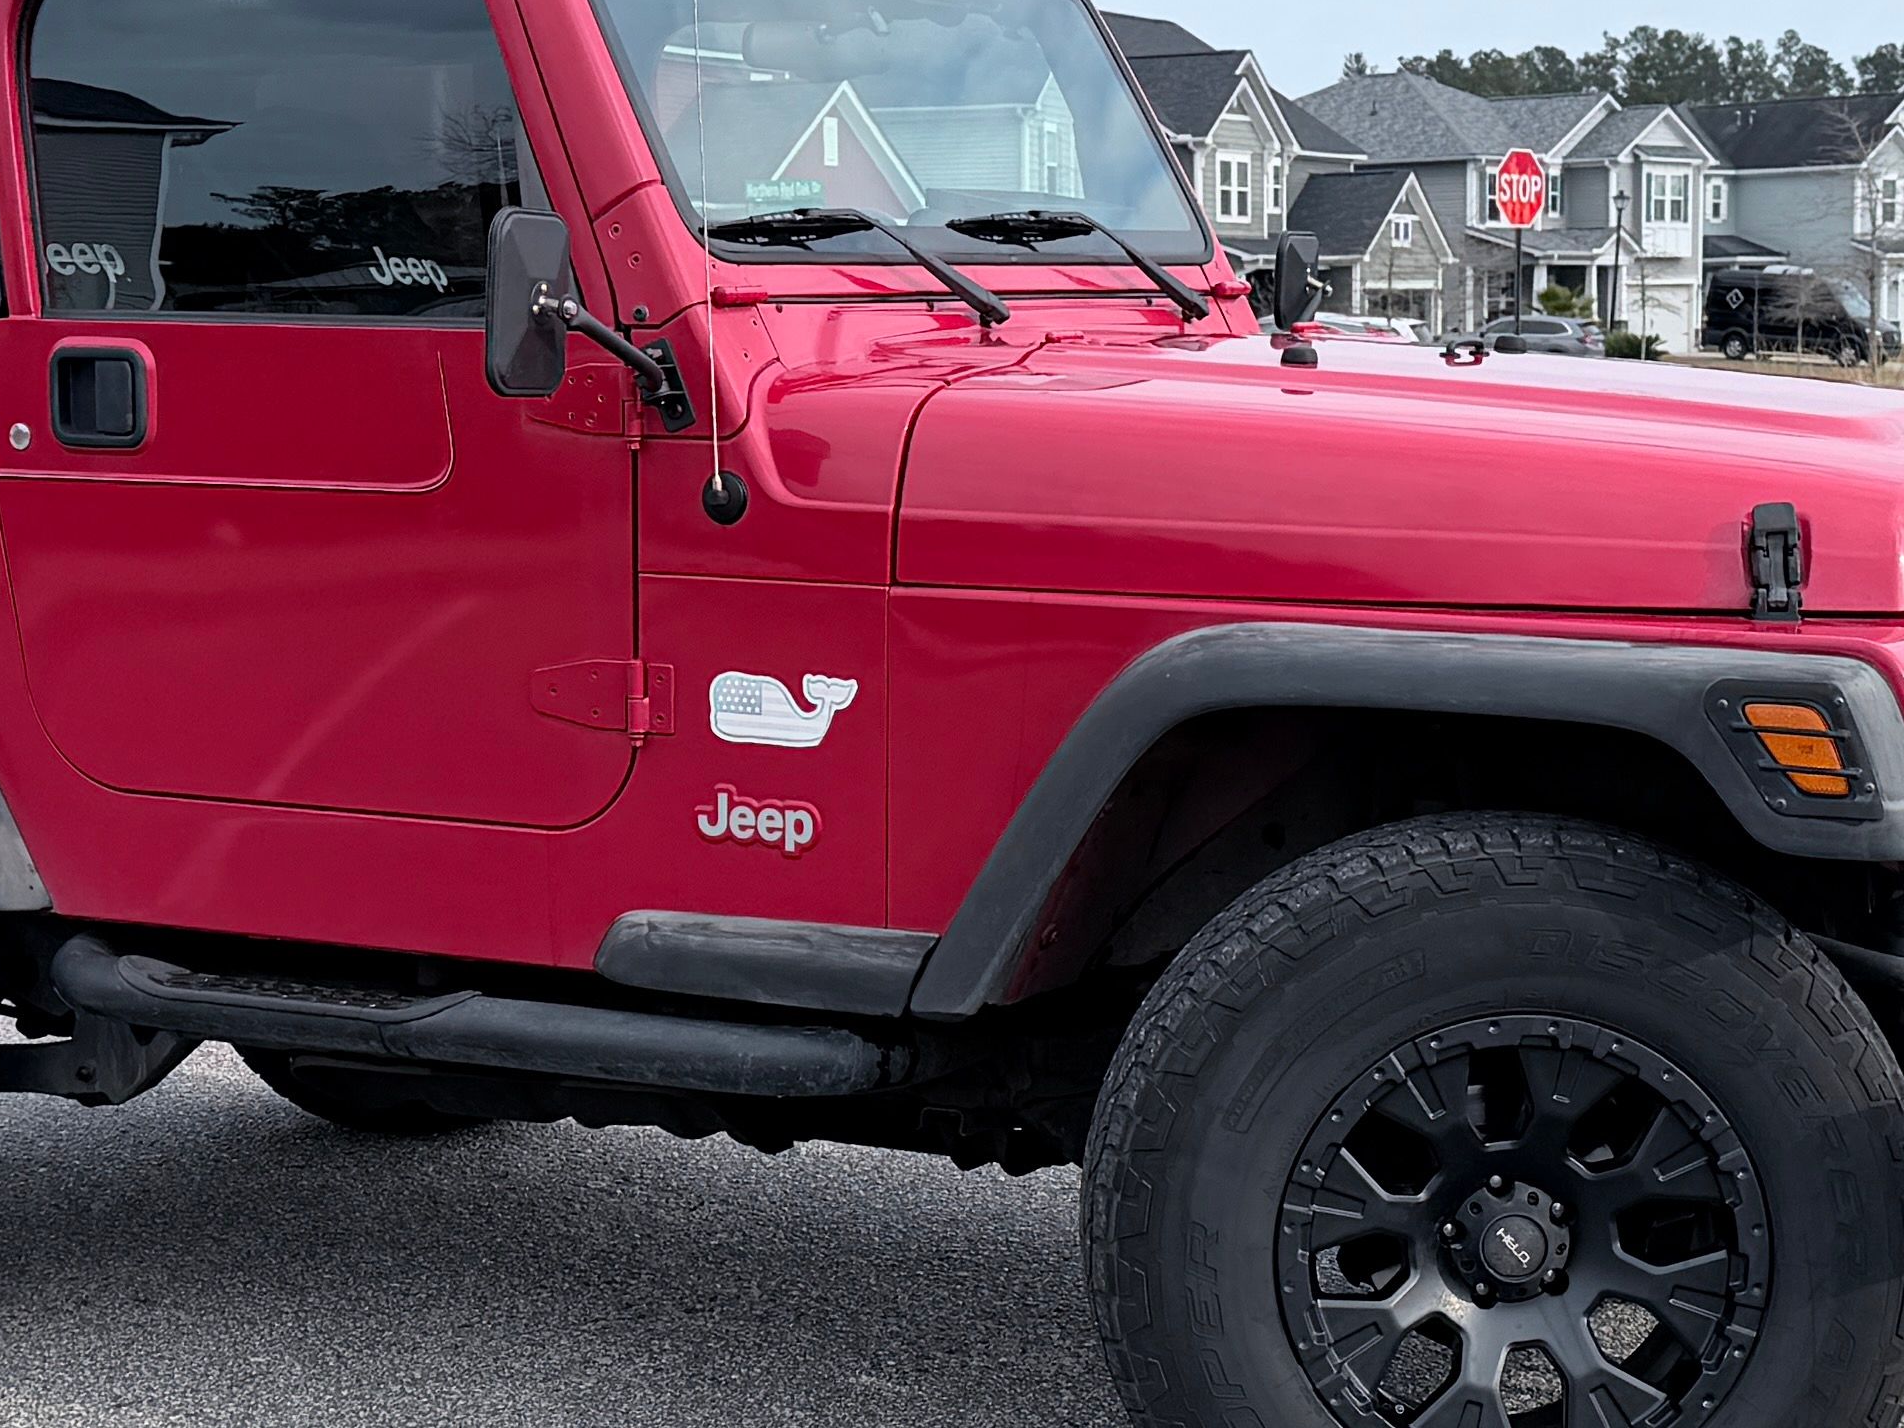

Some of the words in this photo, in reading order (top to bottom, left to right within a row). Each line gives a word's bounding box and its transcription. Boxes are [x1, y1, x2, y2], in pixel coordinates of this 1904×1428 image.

[1500, 173, 1542, 203] STOP
[43, 243, 125, 283] eep
[368, 245, 448, 293] Jeep
[697, 792, 814, 852] Jeep
[1529, 927, 1864, 1279] DISCOVERER
[1496, 1227, 1531, 1266] HELO
